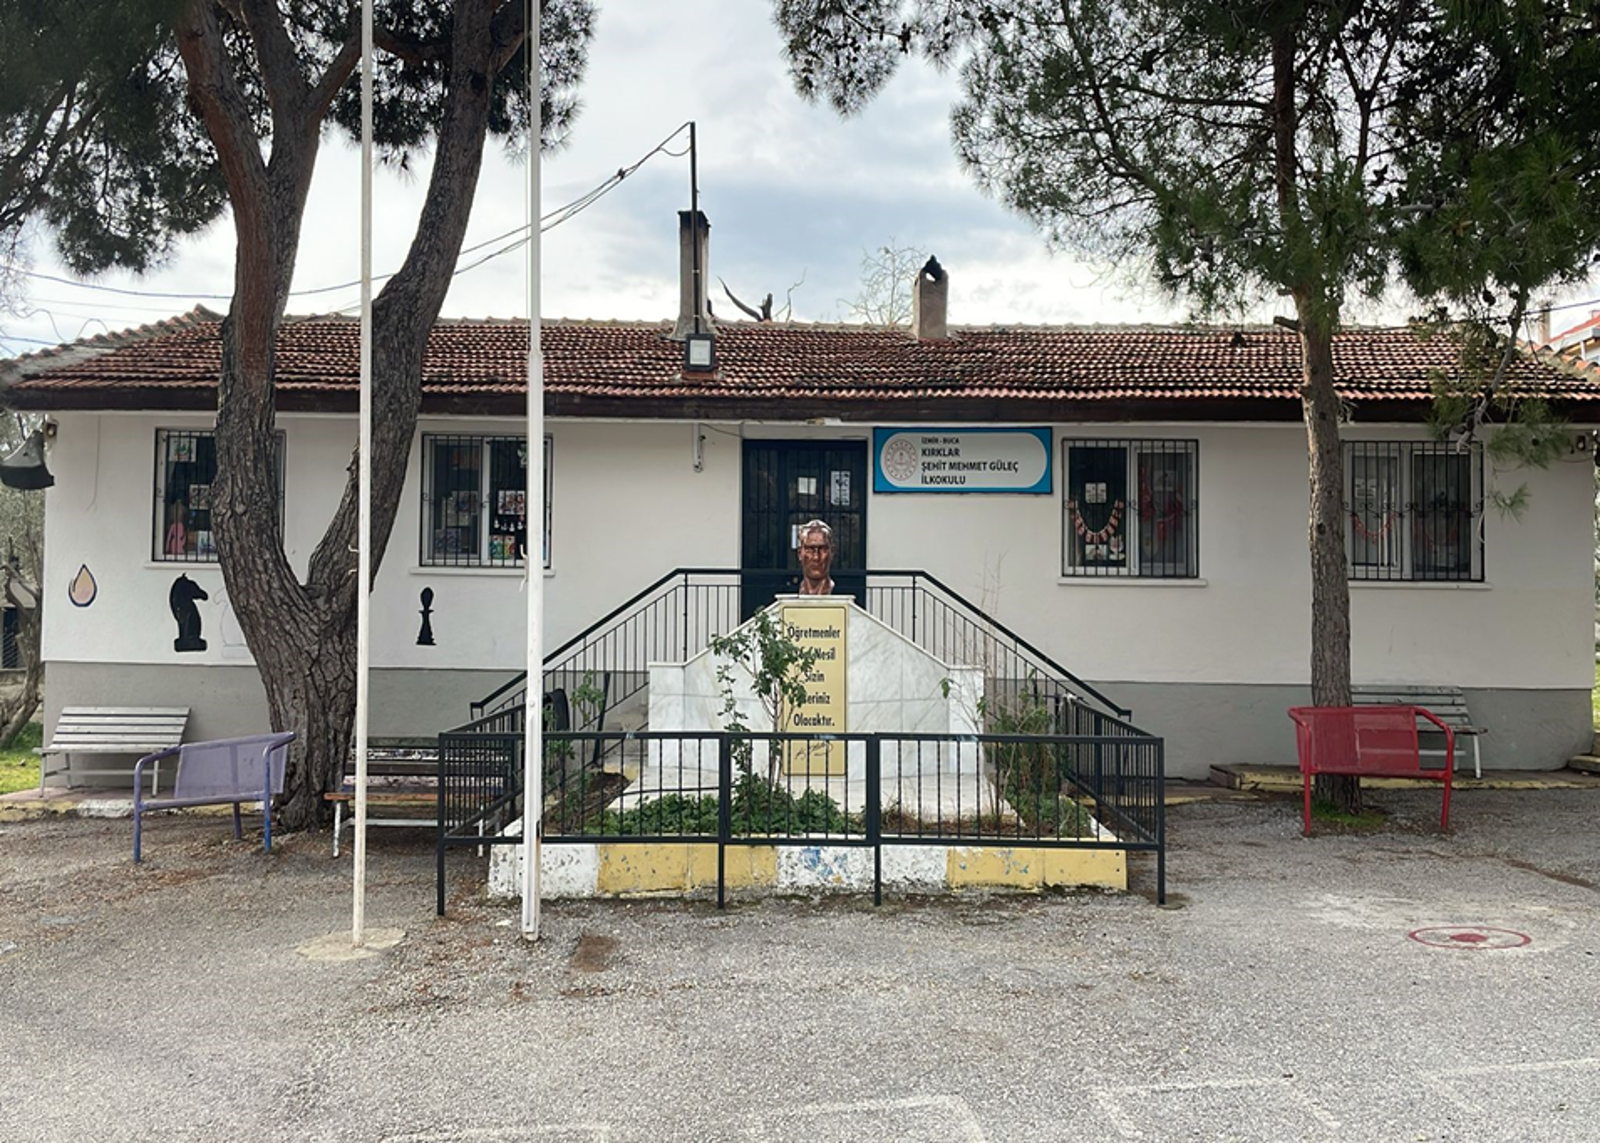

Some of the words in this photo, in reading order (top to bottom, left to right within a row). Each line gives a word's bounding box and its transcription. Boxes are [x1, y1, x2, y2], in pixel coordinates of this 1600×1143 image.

[921, 448, 960, 457] KIRKLAR
[921, 460, 947, 472] ŞEHİT
[949, 461, 987, 471] MEHMET
[989, 459, 1018, 473] GÜLEÇ
[921, 475, 966, 485] İLKOKULU
[787, 622, 841, 641] Öğretmenler
[815, 647, 836, 660] Nesil
[805, 669, 824, 682] Sizin
